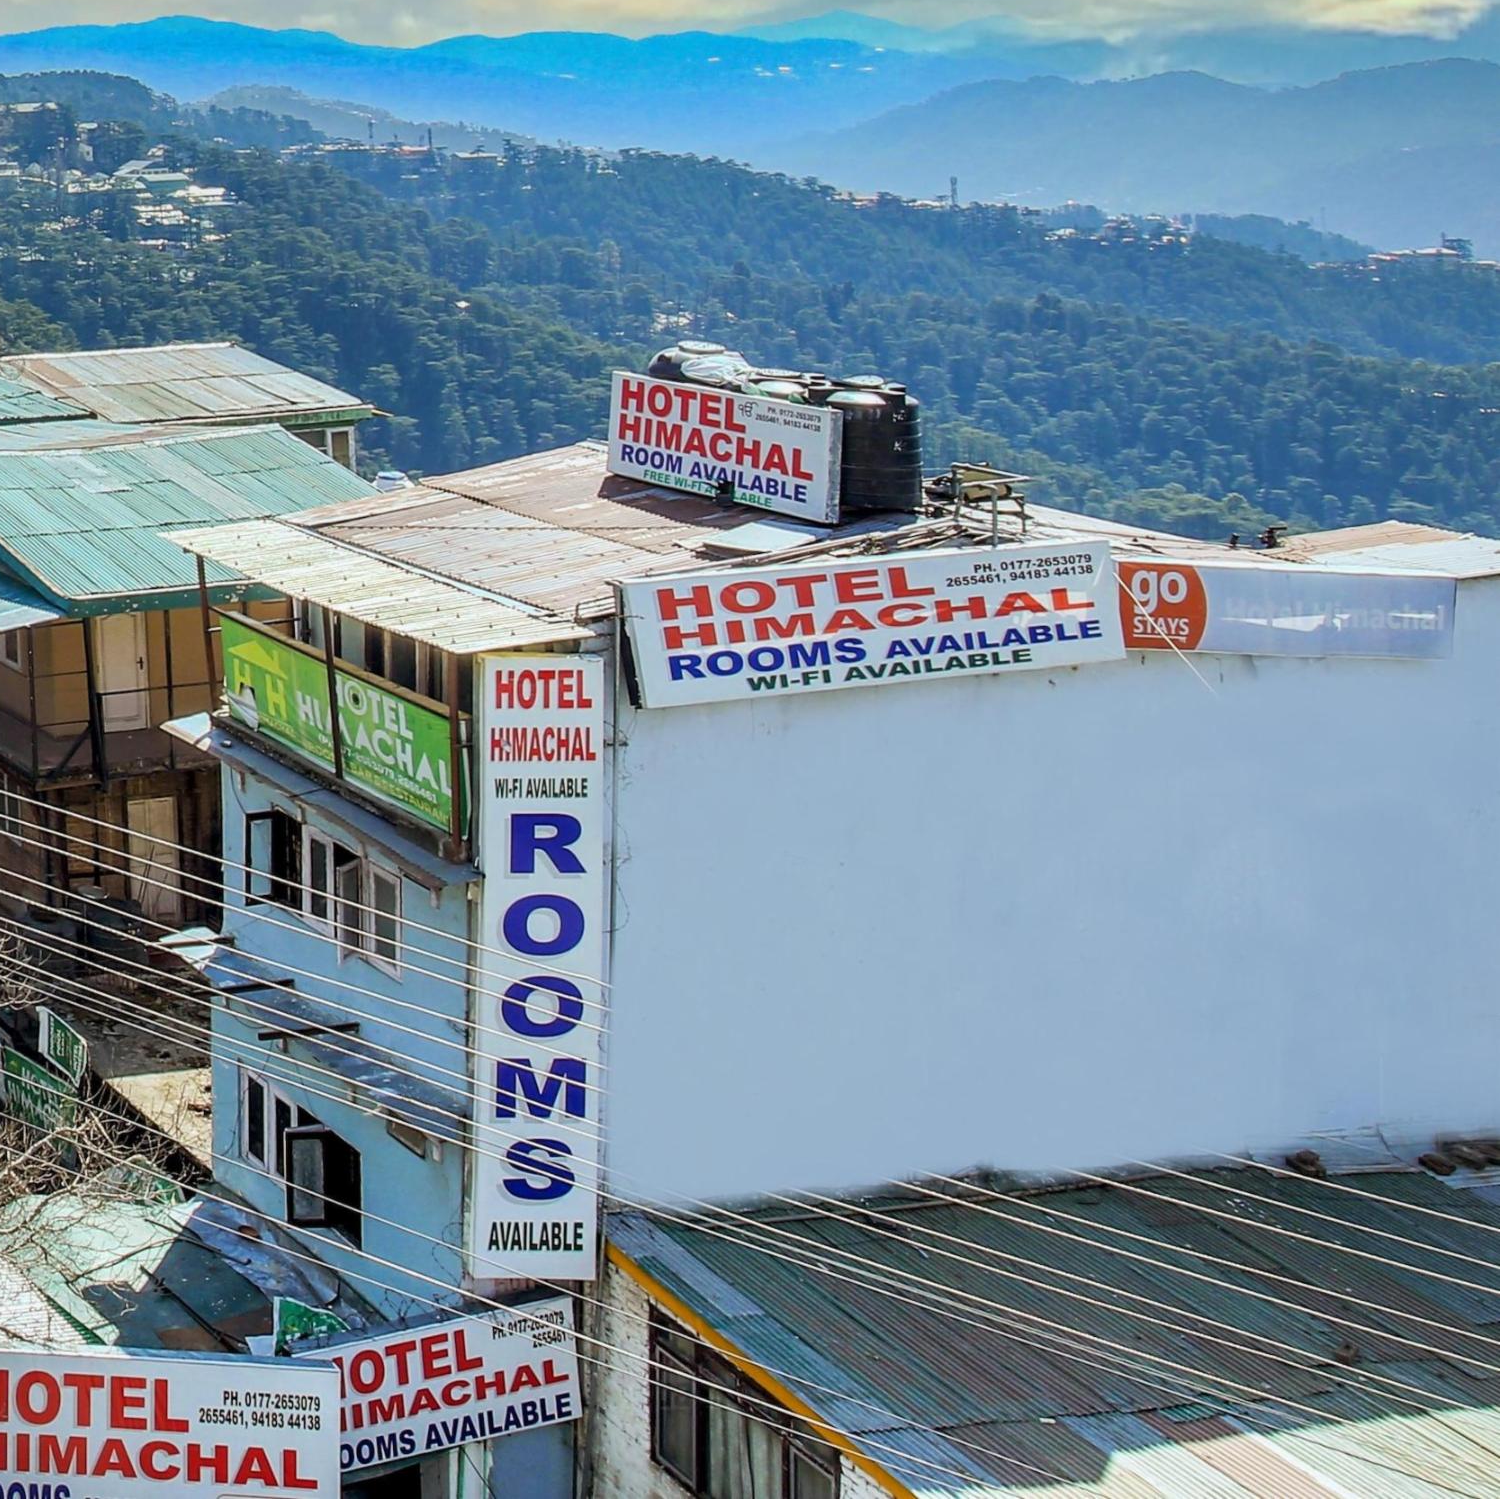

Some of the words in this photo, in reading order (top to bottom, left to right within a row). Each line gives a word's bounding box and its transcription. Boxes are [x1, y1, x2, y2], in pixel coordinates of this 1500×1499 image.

[620, 379, 746, 433] HOTEL
[618, 413, 814, 481] HIMACHAL
[621, 444, 683, 474] ROOM
[689, 461, 808, 504] AVAILABLE
[643, 469, 671, 485] FREE
[674, 477, 703, 493] WI-FI
[946, 574, 1006, 587] 2655461,
[1010, 569, 1050, 581] 94183
[1053, 564, 1094, 577] 44138
[973, 562, 996, 574] PH.
[1000, 554, 1092, 572] 0177-2653079
[656, 564, 935, 621] HOTEL
[1131, 569, 1188, 614] go
[663, 587, 1095, 649] HIMACHAL
[1133, 618, 1189, 635] STAYS
[668, 637, 867, 681] ROOMS
[885, 619, 1103, 659] AVAILABLE
[746, 669, 831, 691] WI-FI
[844, 648, 1033, 682] AVAILABLE
[495, 669, 593, 709] HOTEL
[490, 727, 596, 762] HIMACHAL
[494, 778, 523, 798] WI-FI
[526, 778, 588, 798] AVAILABLE
[494, 812, 587, 1201] ROOMS
[487, 1222, 584, 1252] AVAILABLE
[199, 1408, 248, 1430] 2655461,
[251, 1411, 285, 1430] 94183
[287, 1413, 321, 1432] 44138
[223, 1390, 242, 1409] PH.
[245, 1391, 321, 1413] 0177-2653079
[340, 1429, 416, 1469] OOMS
[425, 1392, 573, 1449] AVAILABLE
